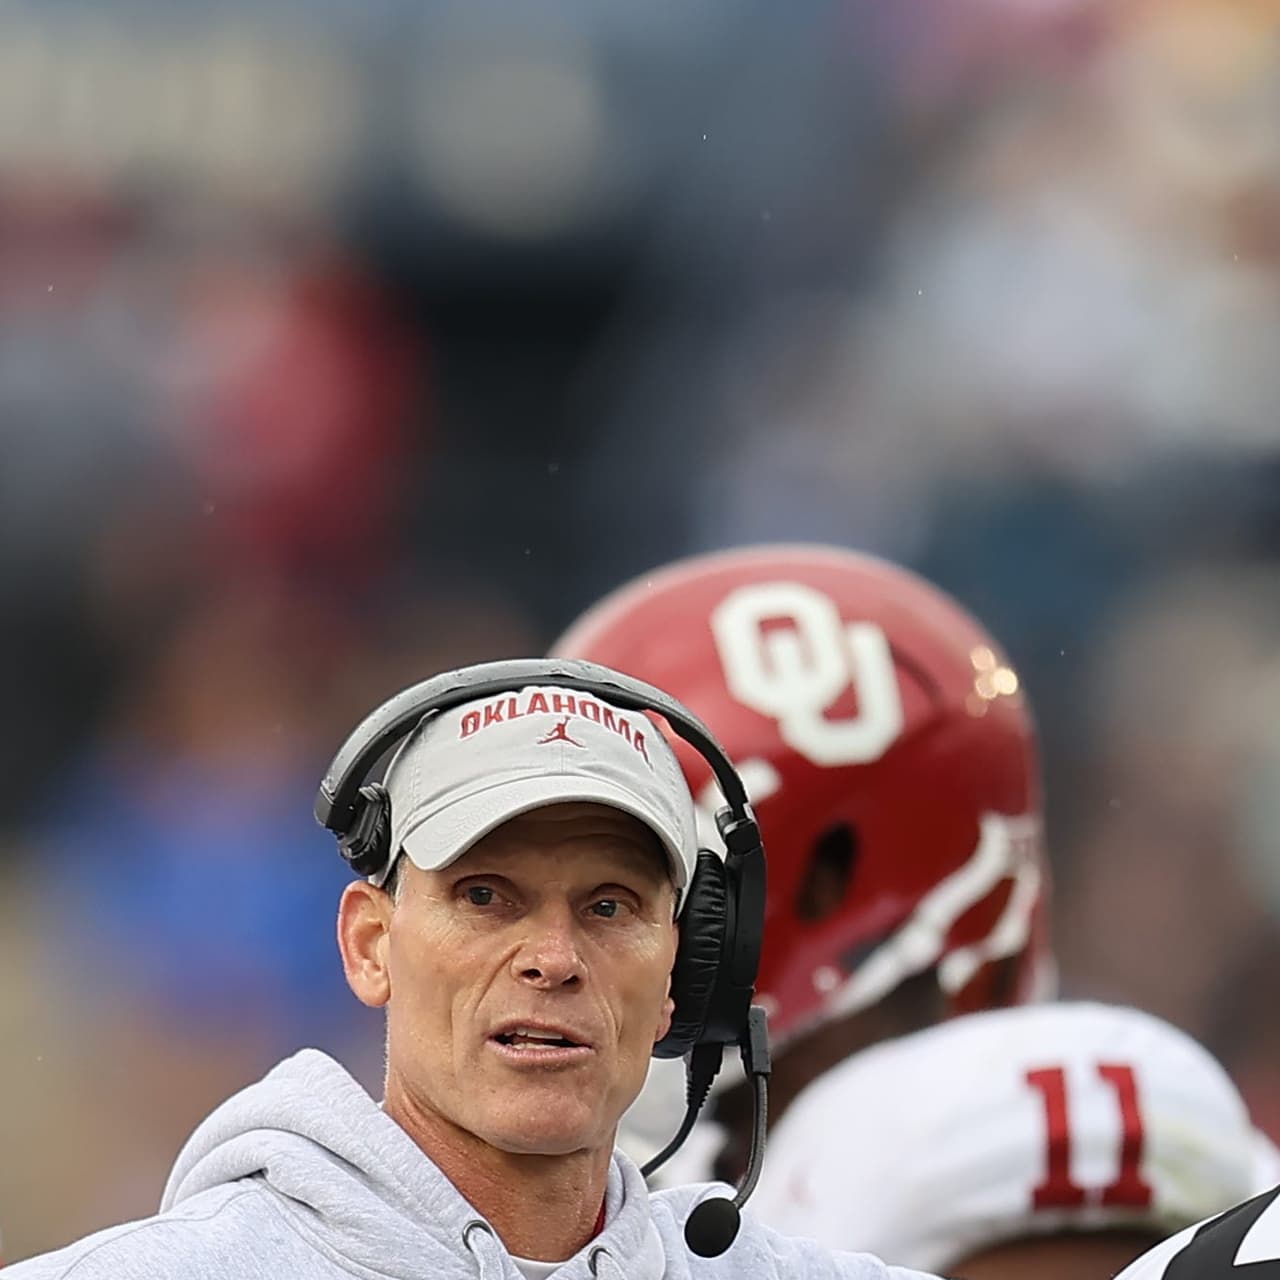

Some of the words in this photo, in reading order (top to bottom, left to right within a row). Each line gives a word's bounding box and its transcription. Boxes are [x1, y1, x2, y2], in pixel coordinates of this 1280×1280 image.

[459, 692, 652, 770] OKLAHOMA
[711, 579, 905, 767] OU
[1026, 1063, 1156, 1213] 11
